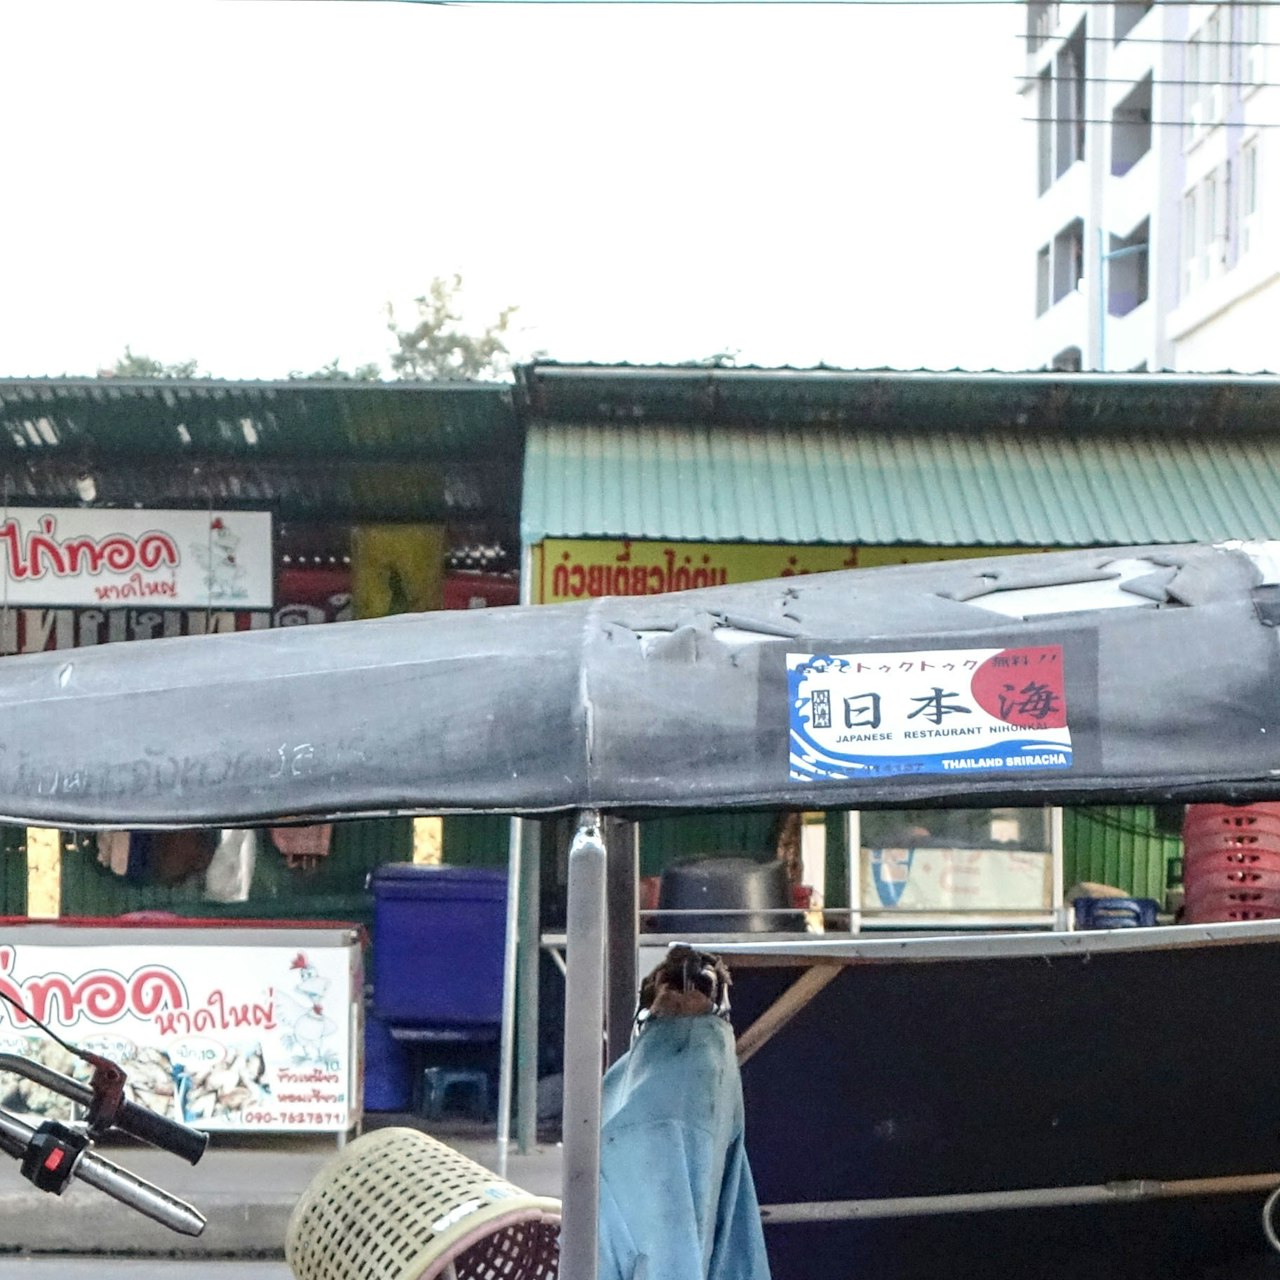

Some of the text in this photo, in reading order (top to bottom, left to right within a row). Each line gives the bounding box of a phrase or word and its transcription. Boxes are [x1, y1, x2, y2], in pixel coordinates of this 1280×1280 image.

[93, 573, 177, 600] หาดใหญ่
[843, 681, 1060, 729] 日本海
[836, 732, 893, 743] JAPANESE
[904, 727, 983, 739] RESTAURANT
[942, 753, 1067, 770] THAILAND SRIRACHA
[155, 990, 278, 1036] หาดใหญ่
